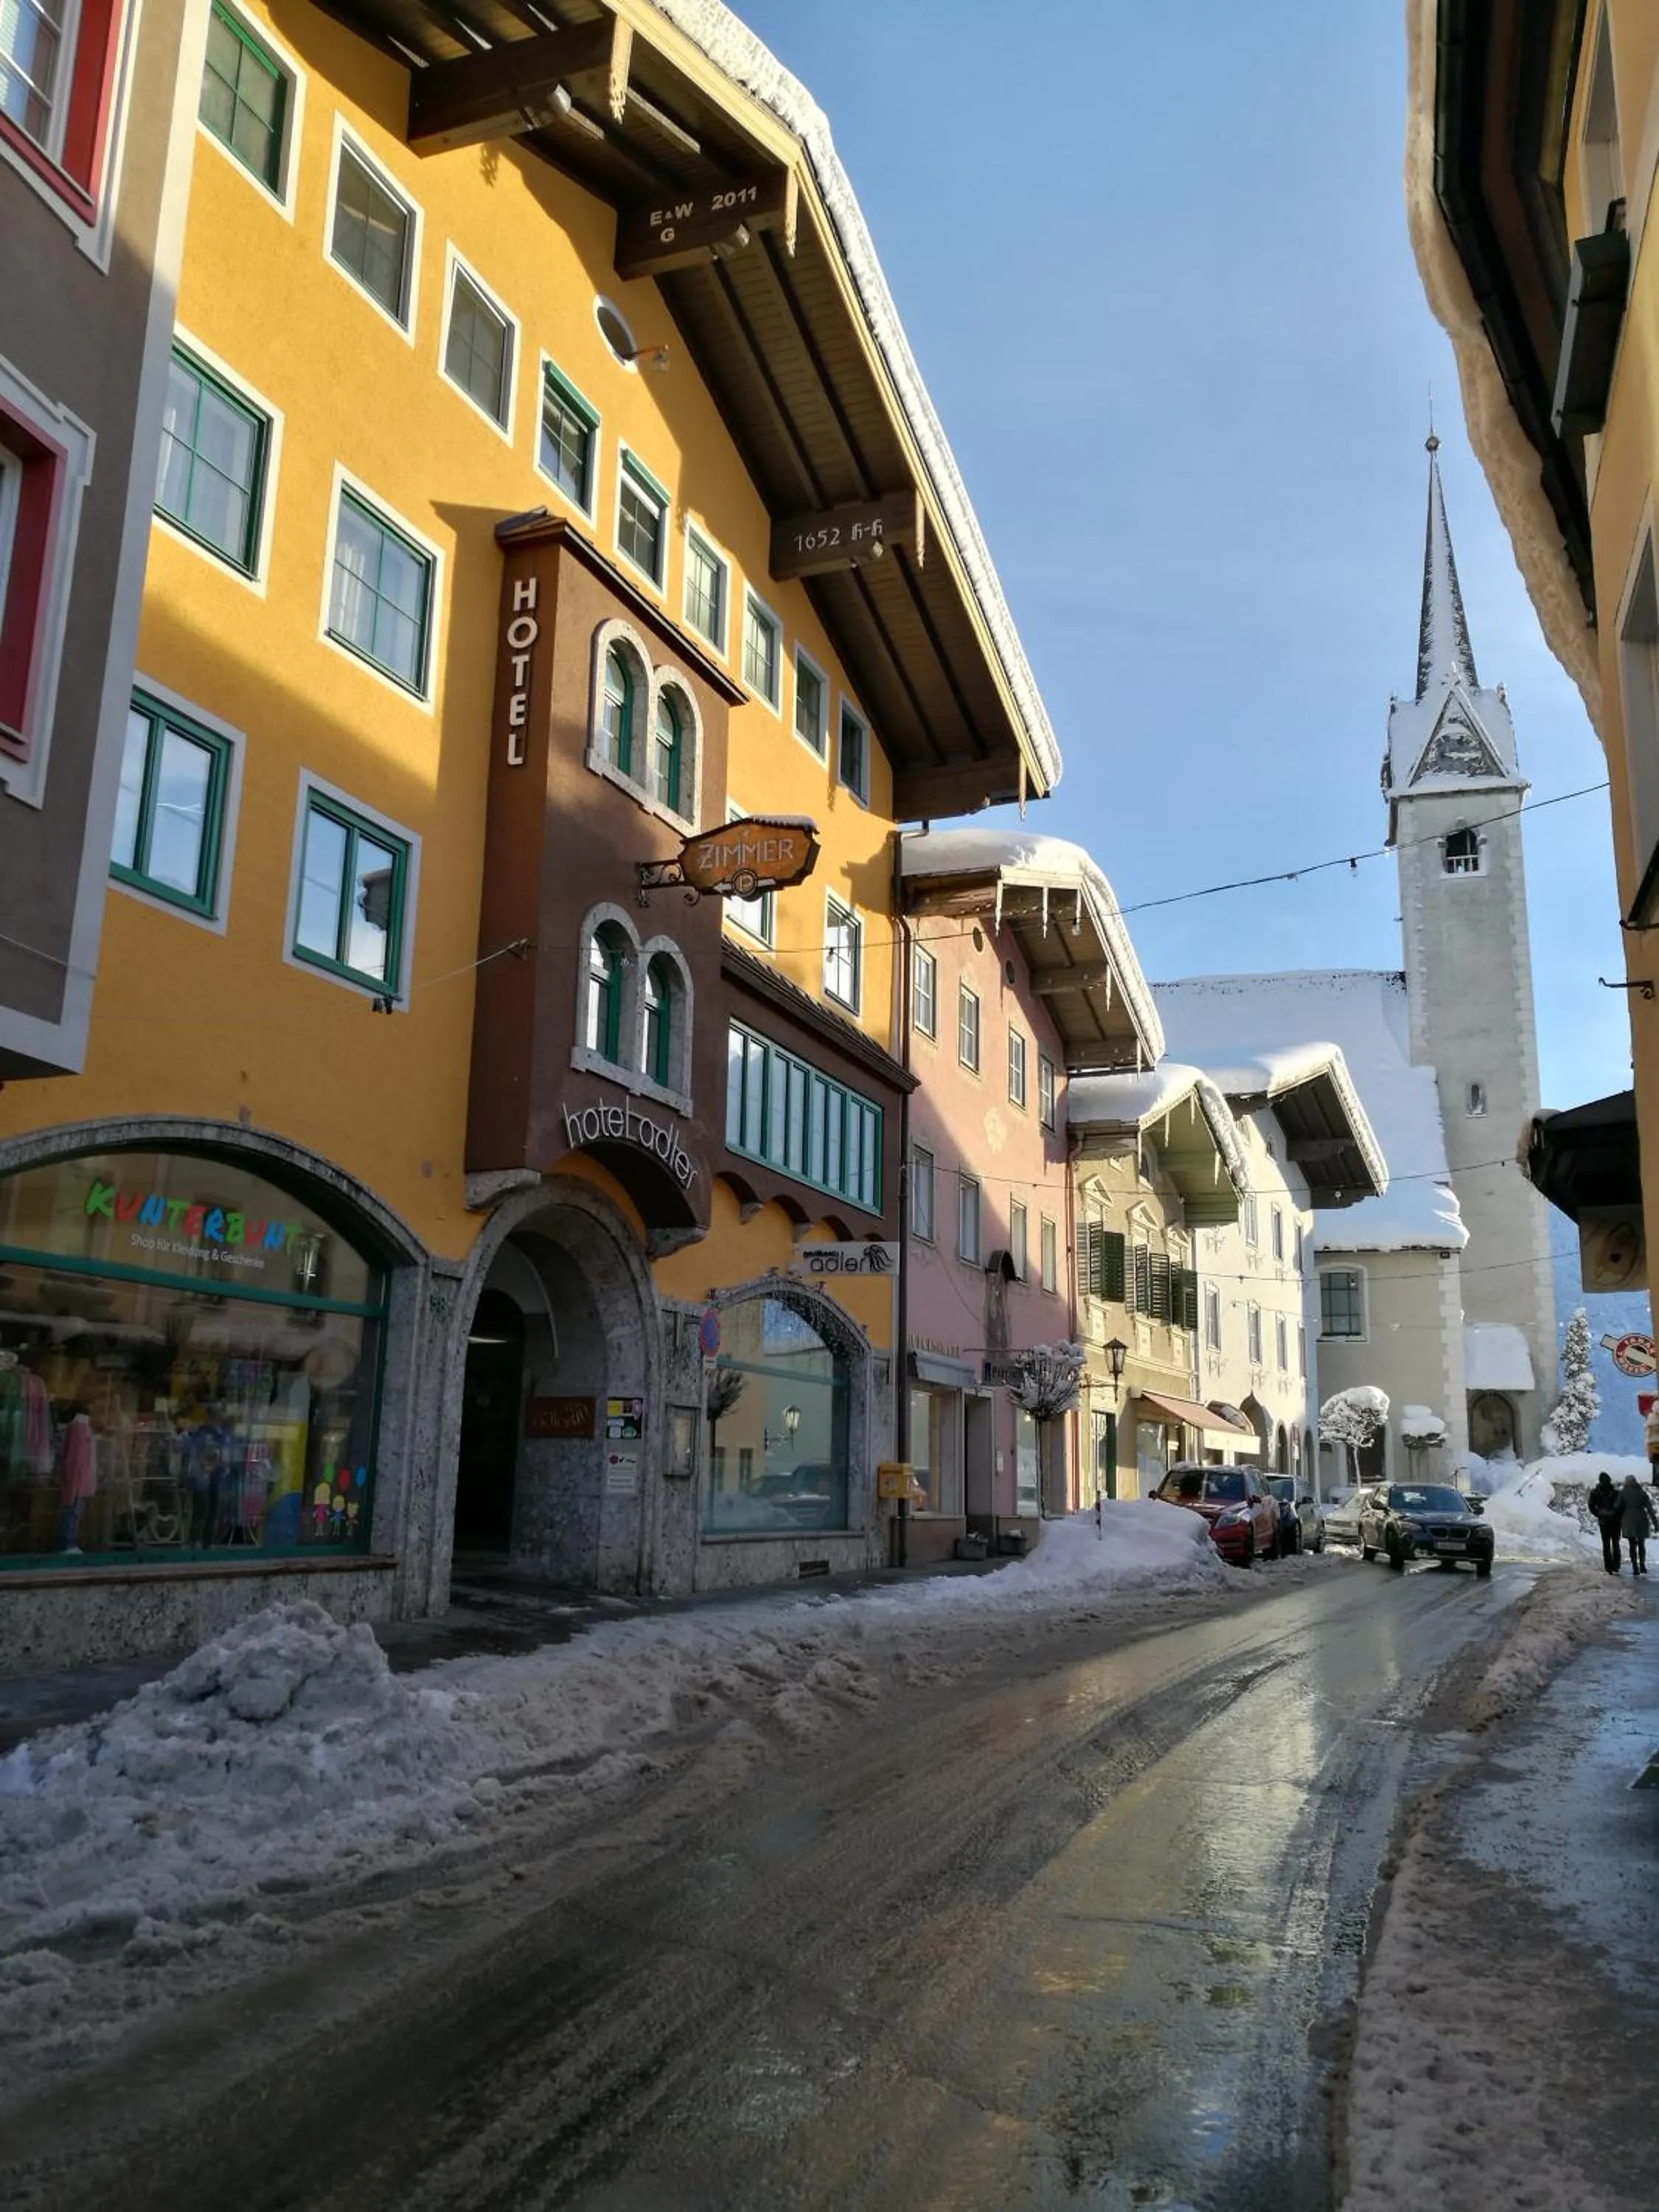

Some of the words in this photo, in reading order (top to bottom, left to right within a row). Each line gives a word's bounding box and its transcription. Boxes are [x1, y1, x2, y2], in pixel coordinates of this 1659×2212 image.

[711, 185, 757, 211] 2011
[660, 226, 675, 243] G
[794, 527, 841, 552] 1652
[507, 577, 538, 765] HOTEL
[699, 838, 794, 870] ZIMMER
[563, 1095, 638, 1150] hotel
[639, 1116, 698, 1190] adler
[85, 1178, 304, 1255] KUNTERBUNT
[131, 1233, 155, 1250] Shop
[156, 1239, 170, 1252] für
[810, 1250, 866, 1272] adler
